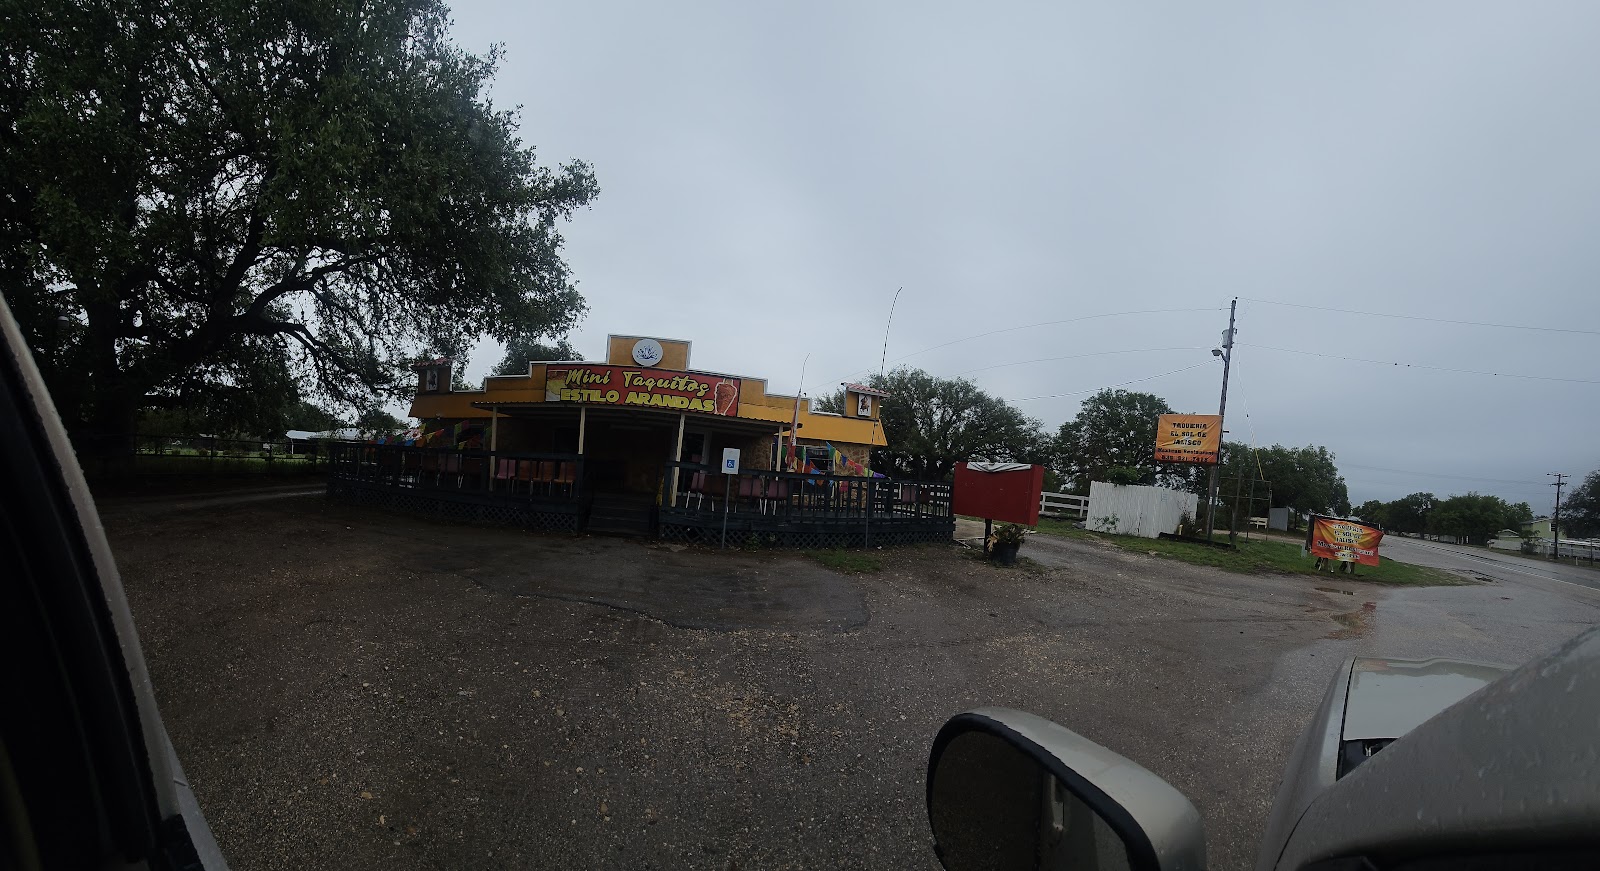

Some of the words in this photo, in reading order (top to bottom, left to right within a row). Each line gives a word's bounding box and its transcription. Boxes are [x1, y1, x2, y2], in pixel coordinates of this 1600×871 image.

[565, 368, 611, 386] Mini
[622, 371, 710, 397] Taquitos
[560, 388, 620, 403] ESTILO
[625, 391, 715, 412] ARANDAS
